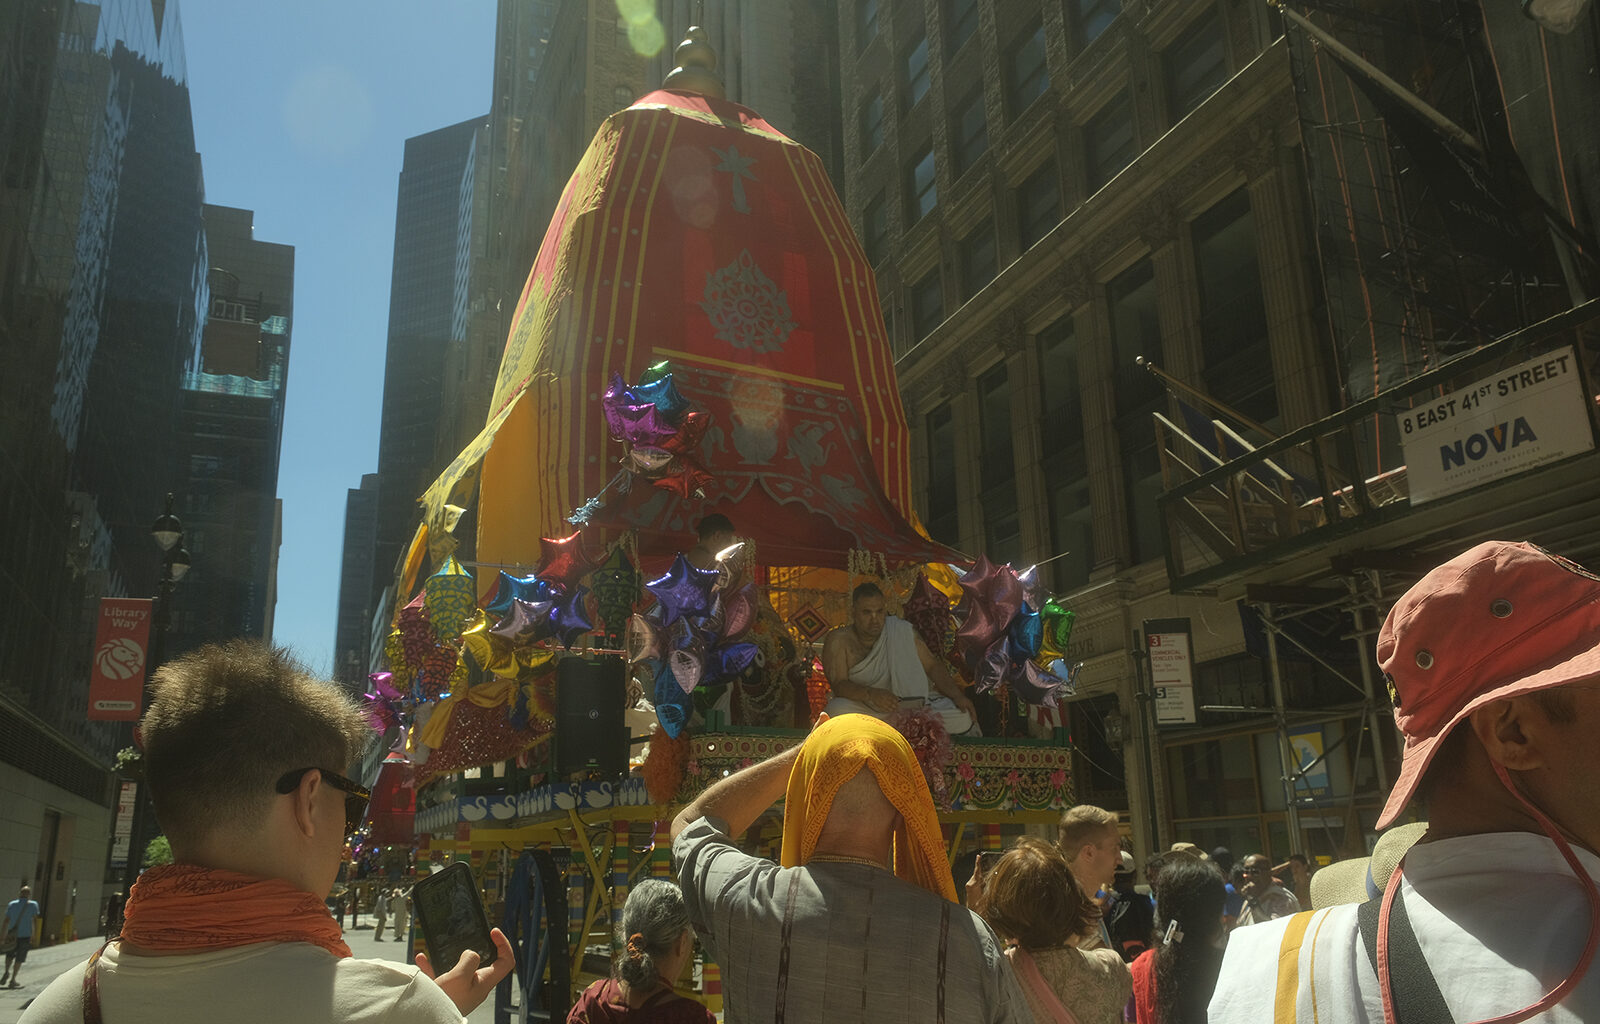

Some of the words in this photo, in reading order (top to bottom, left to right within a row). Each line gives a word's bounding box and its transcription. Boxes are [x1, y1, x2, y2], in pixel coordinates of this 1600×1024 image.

[1403, 418, 1413, 434] 8
[1416, 400, 1457, 431] EAST
[1462, 384, 1492, 412] 41ST
[1497, 354, 1569, 397] STREET
[1440, 416, 1537, 471] NOVA
[104, 607, 148, 620] Library
[112, 618, 138, 630] Way
[1151, 636, 1159, 647] 3
[1156, 688, 1164, 698] 5
